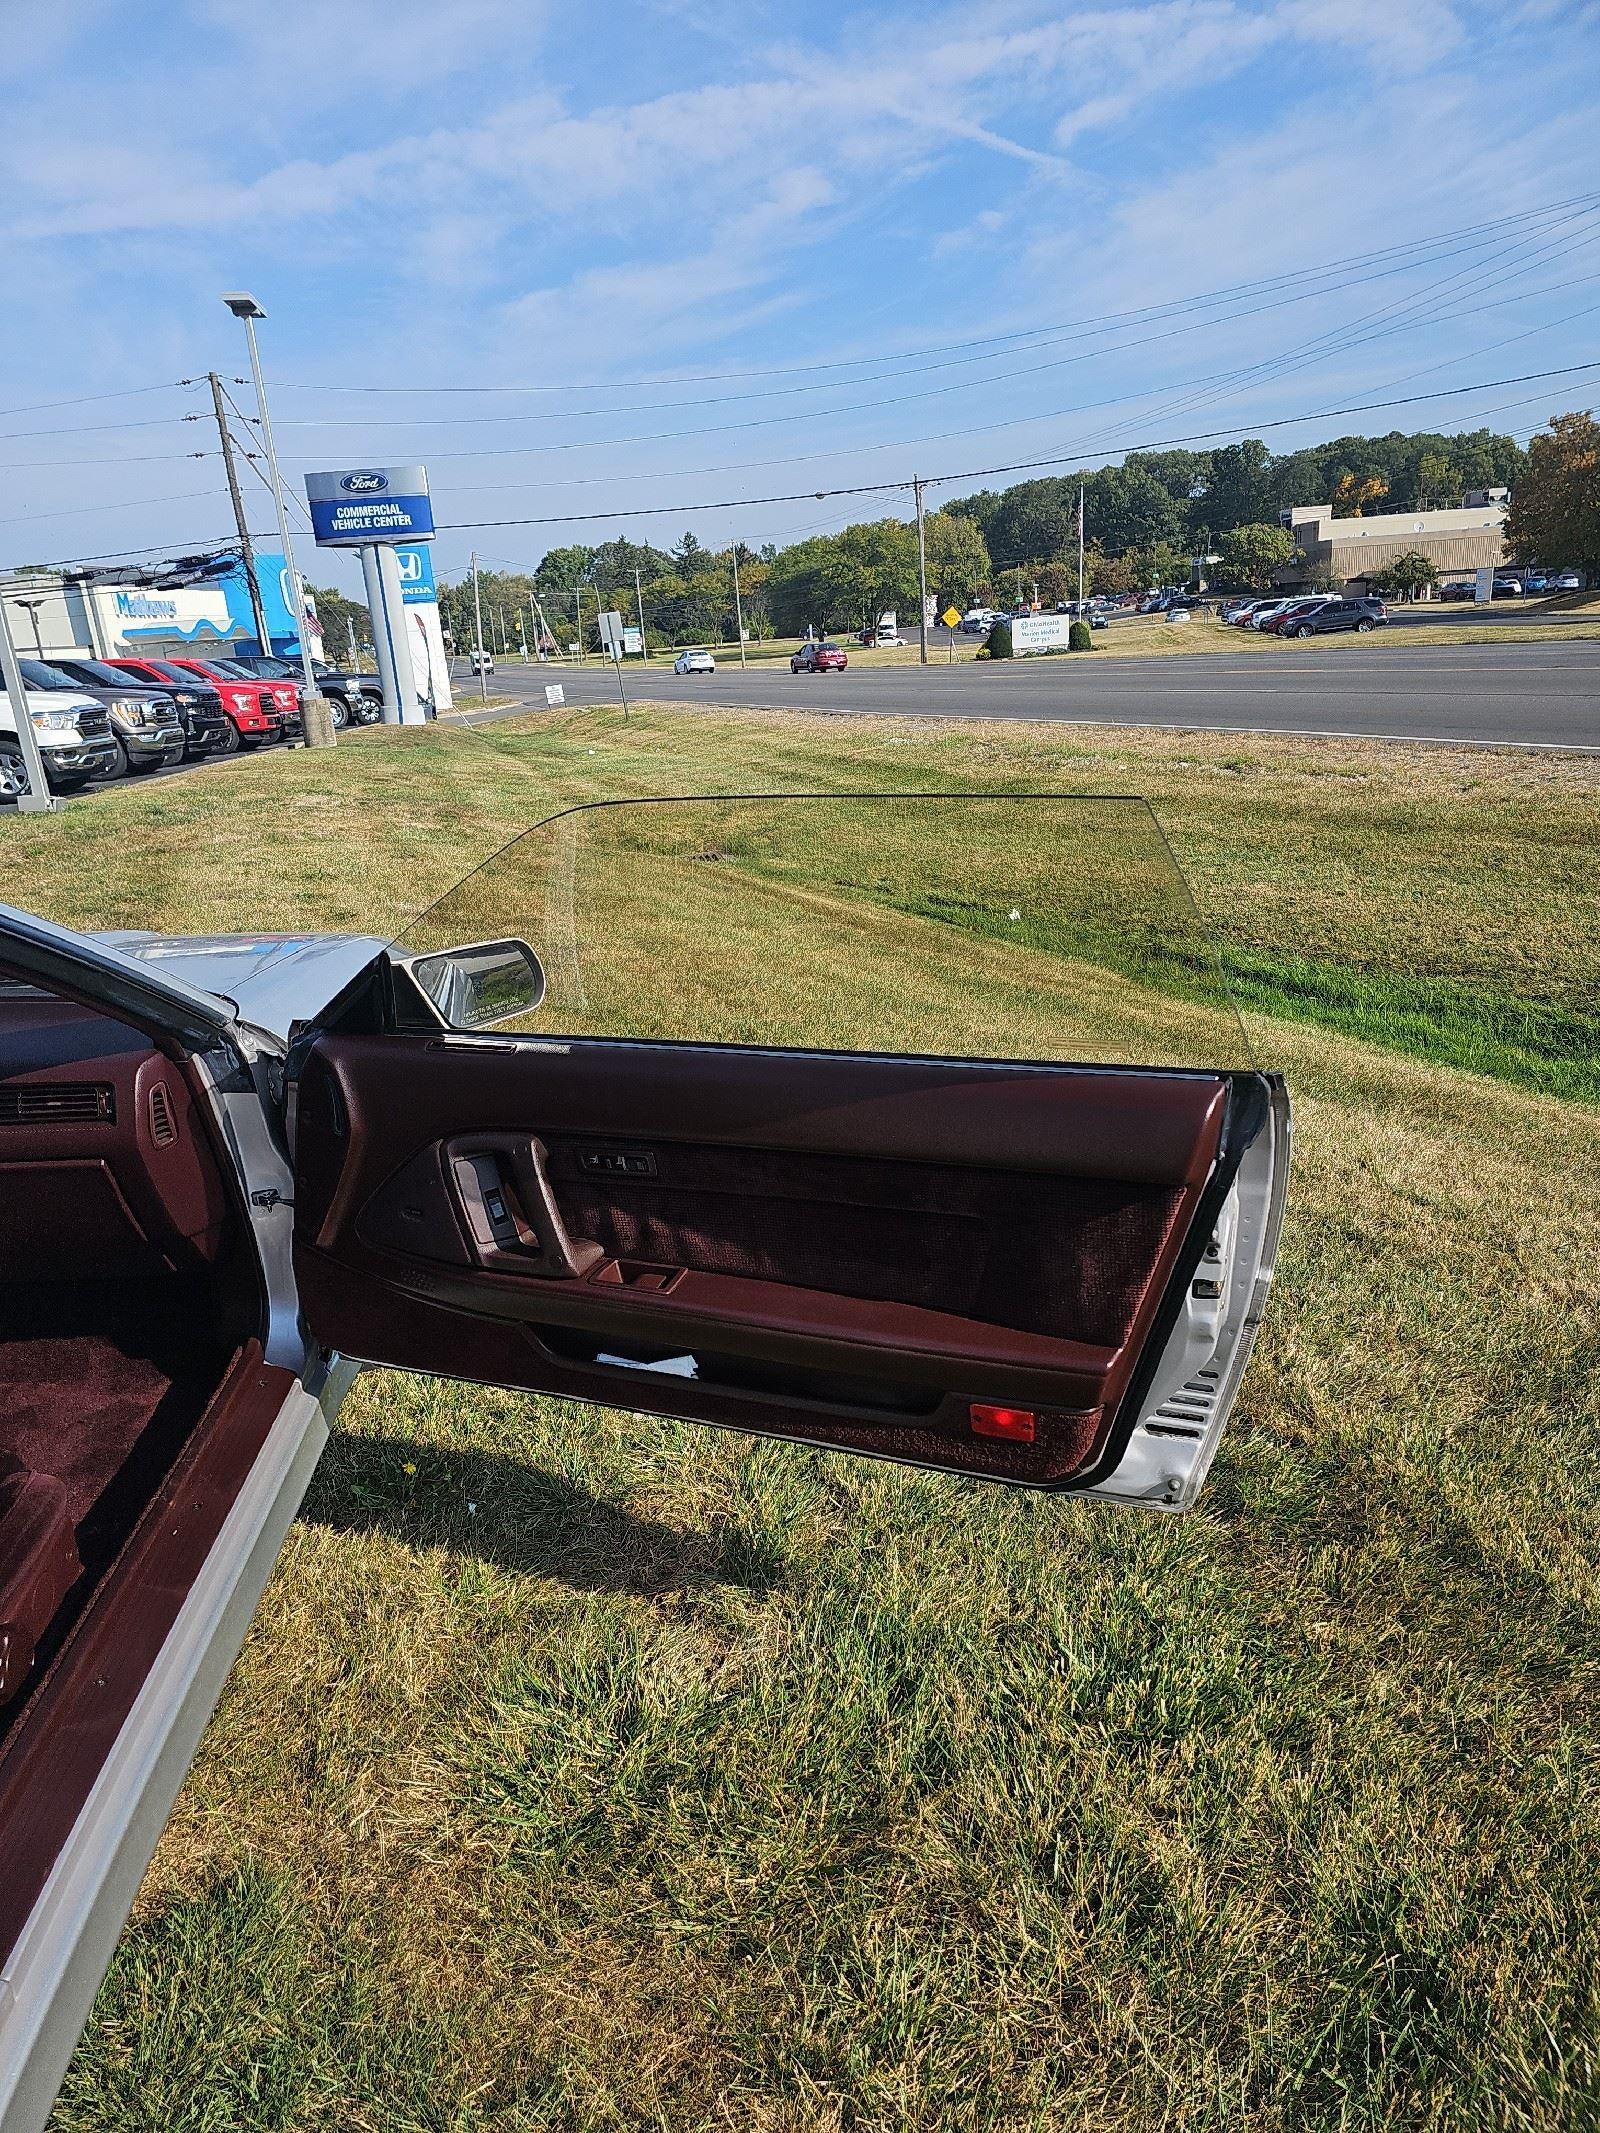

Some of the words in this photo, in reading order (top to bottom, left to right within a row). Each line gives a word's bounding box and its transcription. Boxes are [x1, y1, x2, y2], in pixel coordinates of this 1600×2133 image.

[350, 475, 380, 490] Ford
[336, 503, 403, 519] COMMERCIAL
[331, 517, 373, 531] VEHICLE
[373, 514, 413, 528] CENTER
